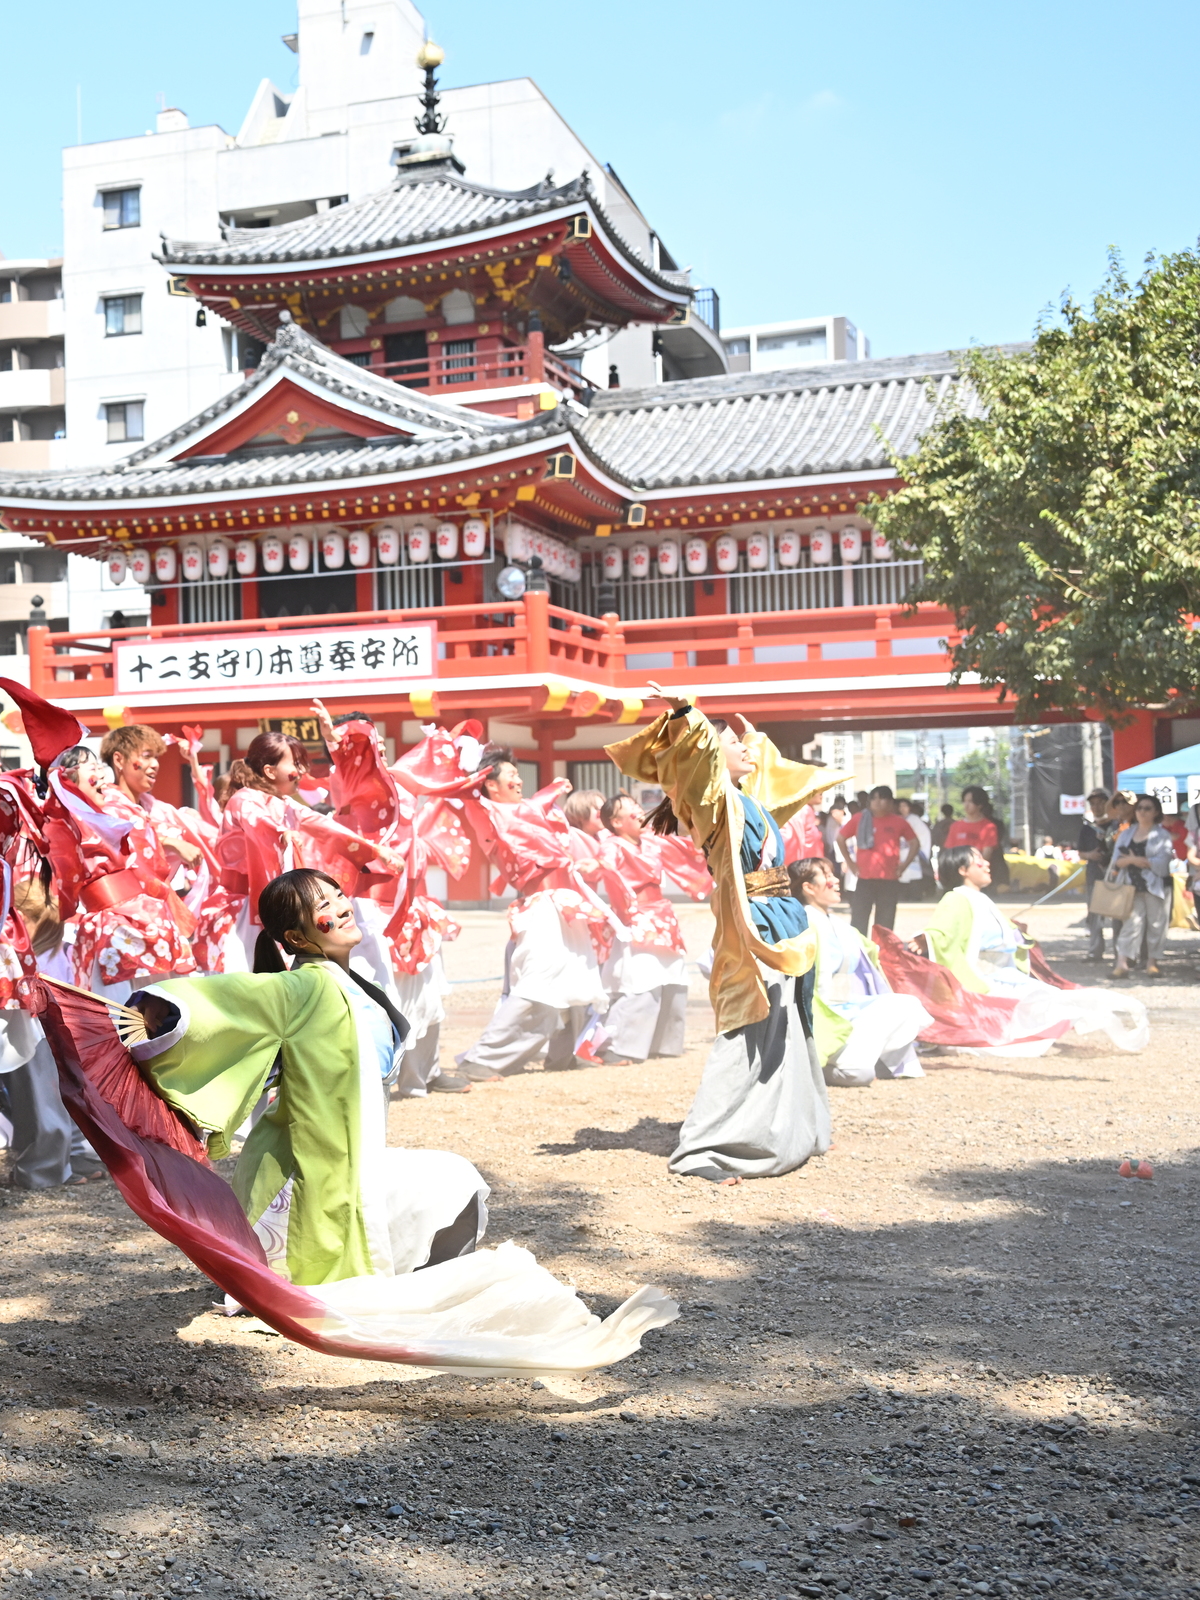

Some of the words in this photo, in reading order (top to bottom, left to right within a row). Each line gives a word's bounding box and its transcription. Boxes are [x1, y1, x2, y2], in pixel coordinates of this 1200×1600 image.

[130, 635, 418, 682] 十二支守り本尊奉安所
